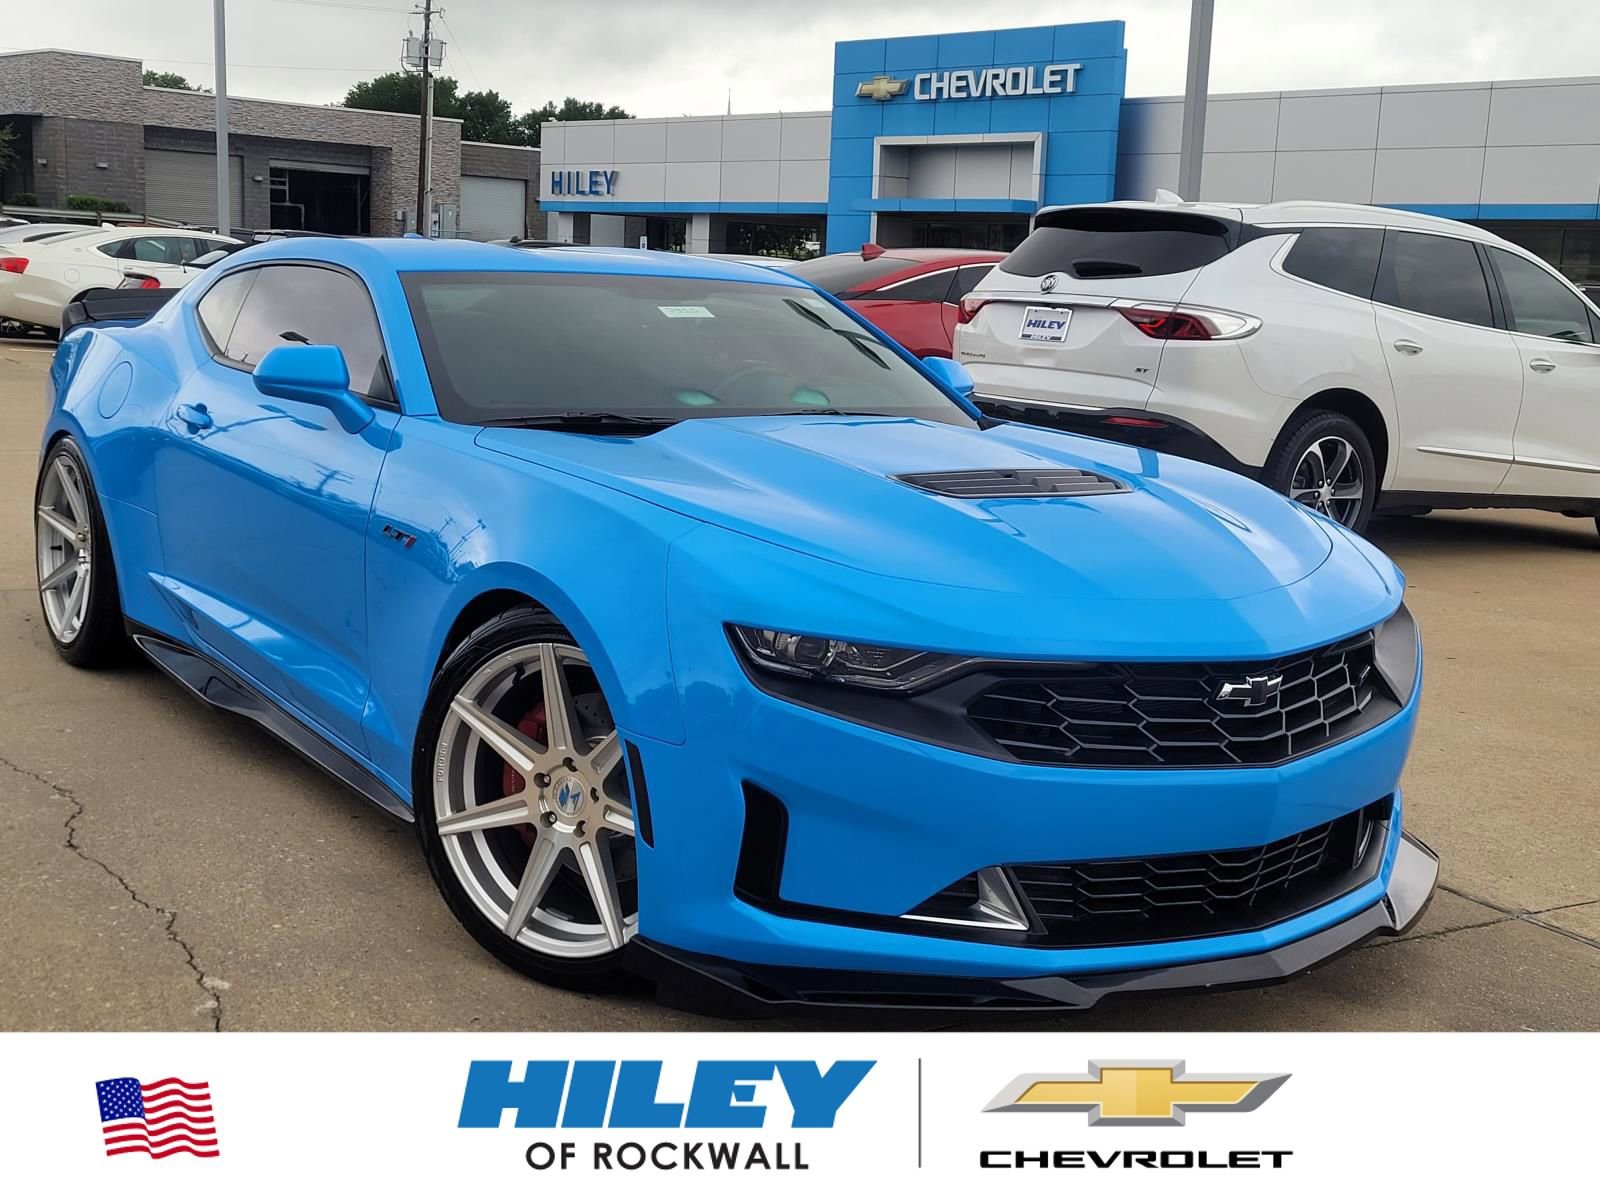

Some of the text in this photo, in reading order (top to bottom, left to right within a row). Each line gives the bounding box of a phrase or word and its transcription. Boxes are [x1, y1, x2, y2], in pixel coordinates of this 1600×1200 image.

[914, 63, 1082, 100] CHEVROLET
[551, 170, 620, 196] HILEY
[1026, 319, 1067, 330] HILEY
